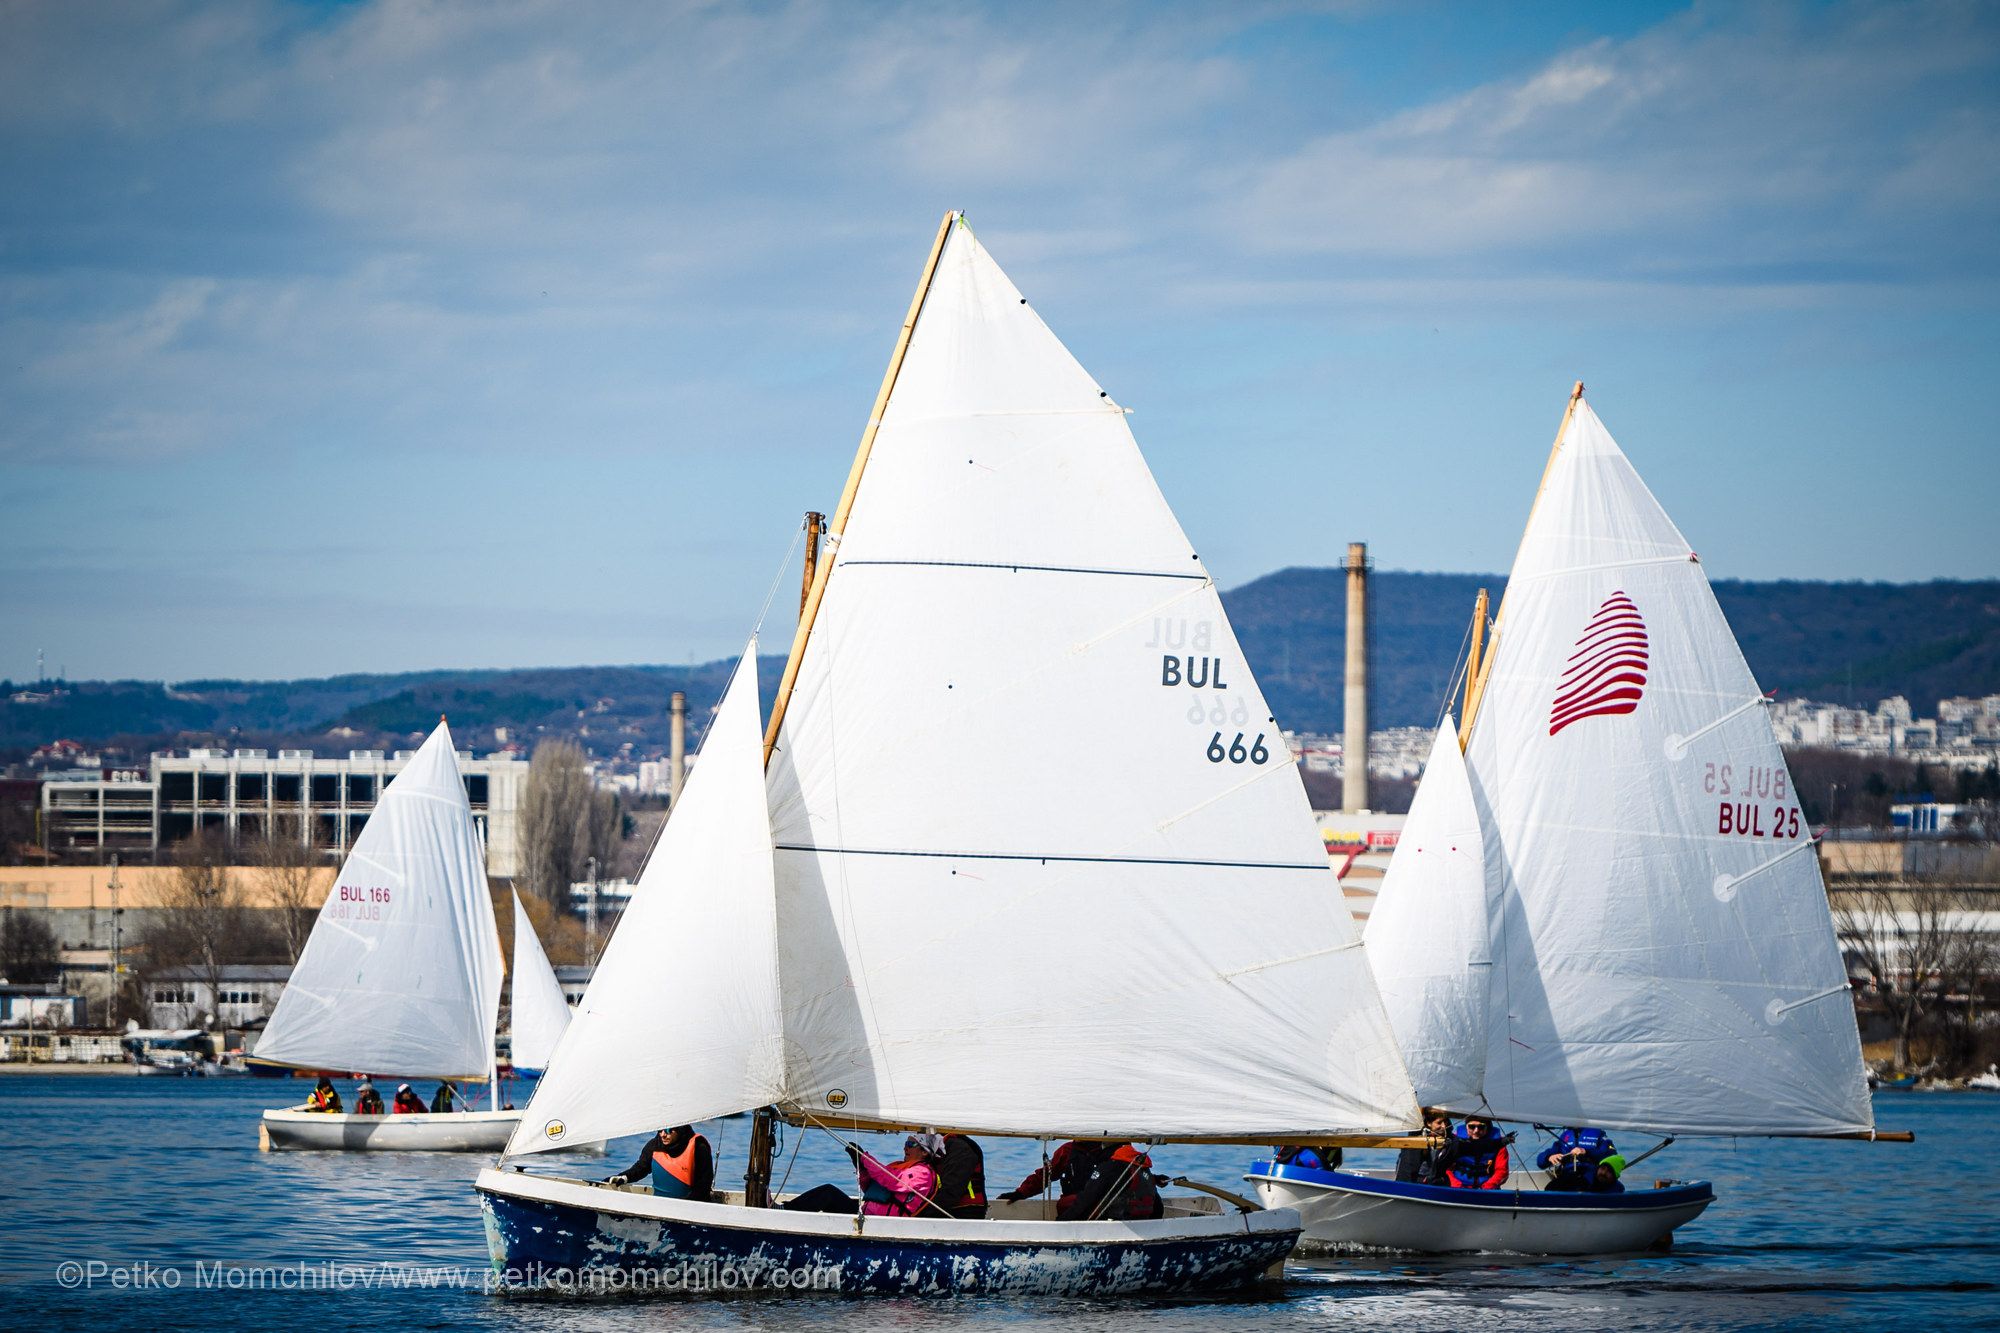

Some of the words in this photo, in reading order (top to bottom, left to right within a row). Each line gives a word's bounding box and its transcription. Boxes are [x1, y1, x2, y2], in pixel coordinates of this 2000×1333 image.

[1162, 655, 1227, 690] BUL
[1206, 731, 1269, 765] 666
[1719, 802, 1764, 837] BUL
[1773, 806, 1799, 839] 25
[340, 886, 365, 902] BUL
[370, 887, 391, 903] 166
